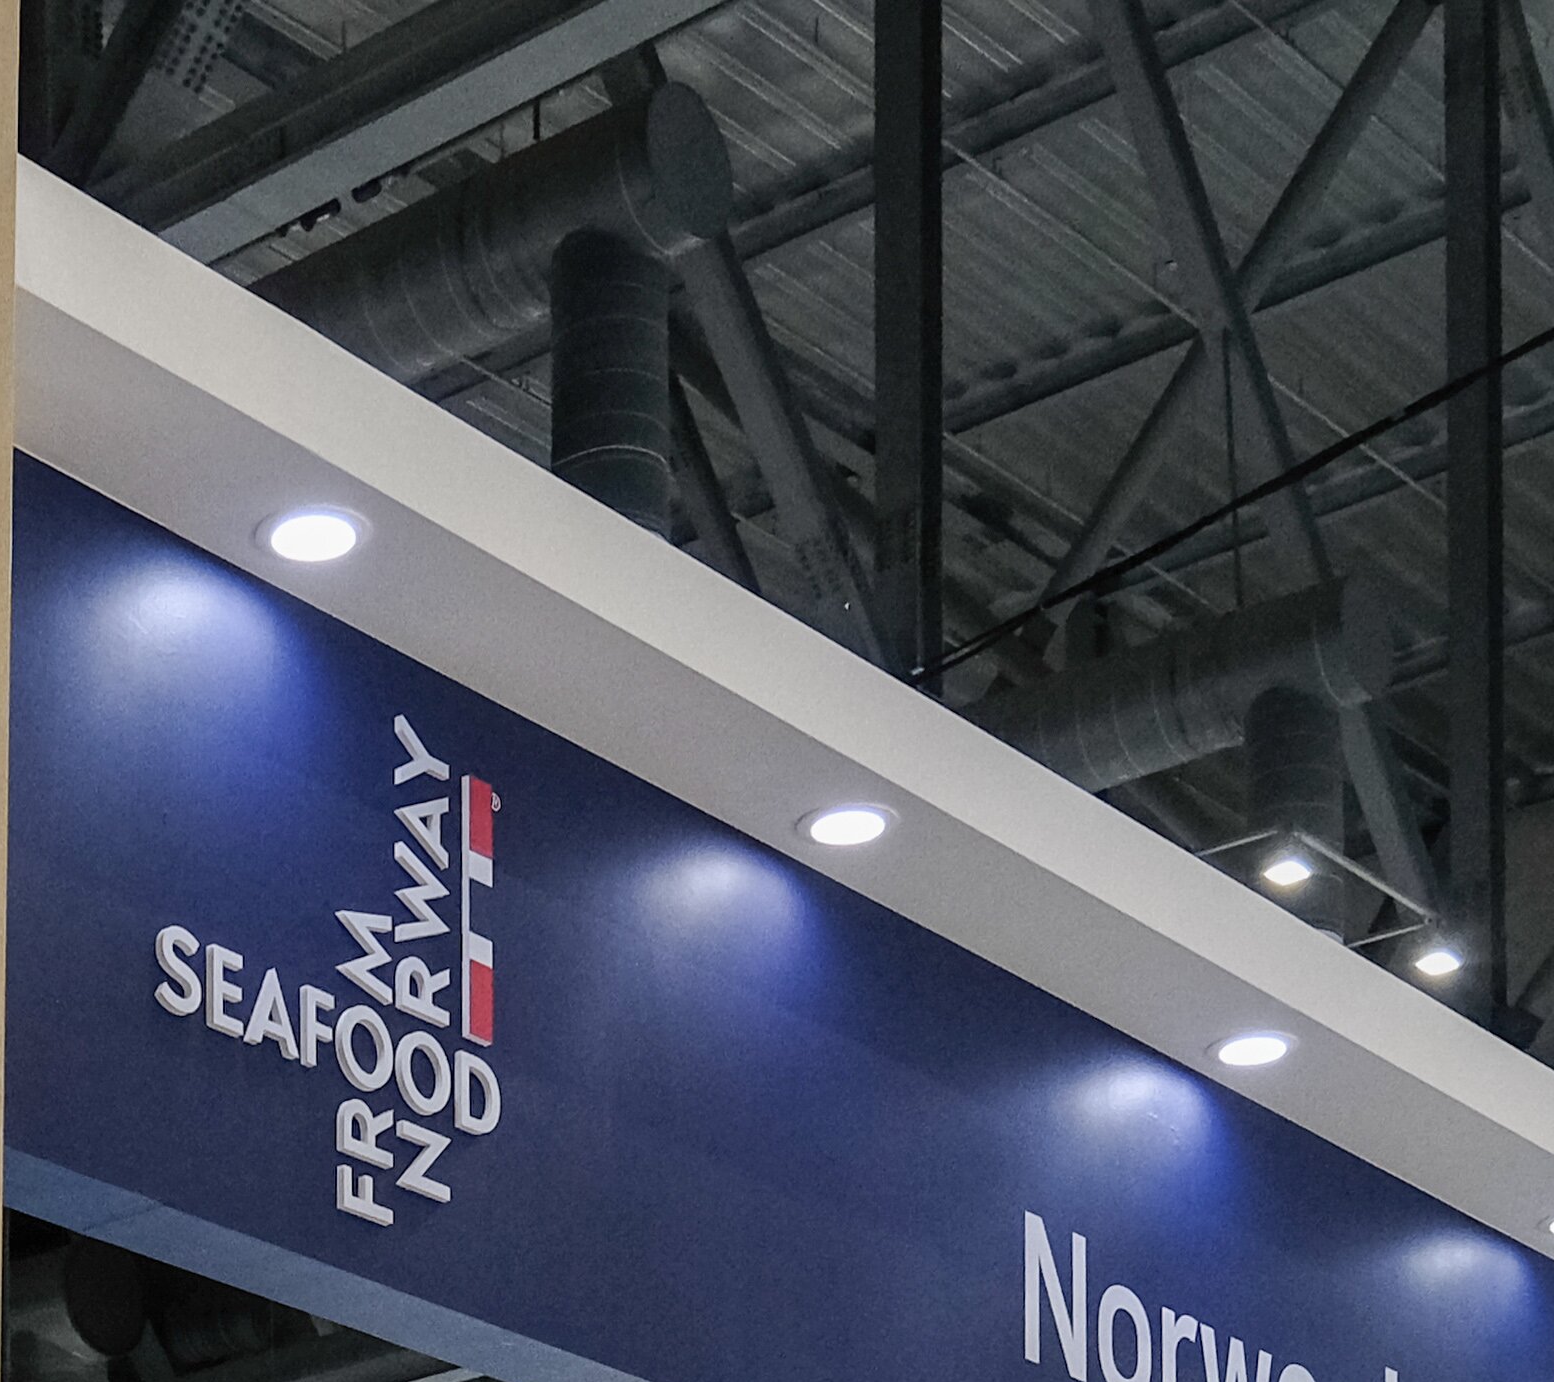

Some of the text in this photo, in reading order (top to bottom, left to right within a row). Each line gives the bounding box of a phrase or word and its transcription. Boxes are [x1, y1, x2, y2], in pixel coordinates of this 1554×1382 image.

[154, 924, 501, 1135] SEAFOOD
[336, 908, 395, 1227] FROM
[394, 714, 451, 1203] NORWAY
